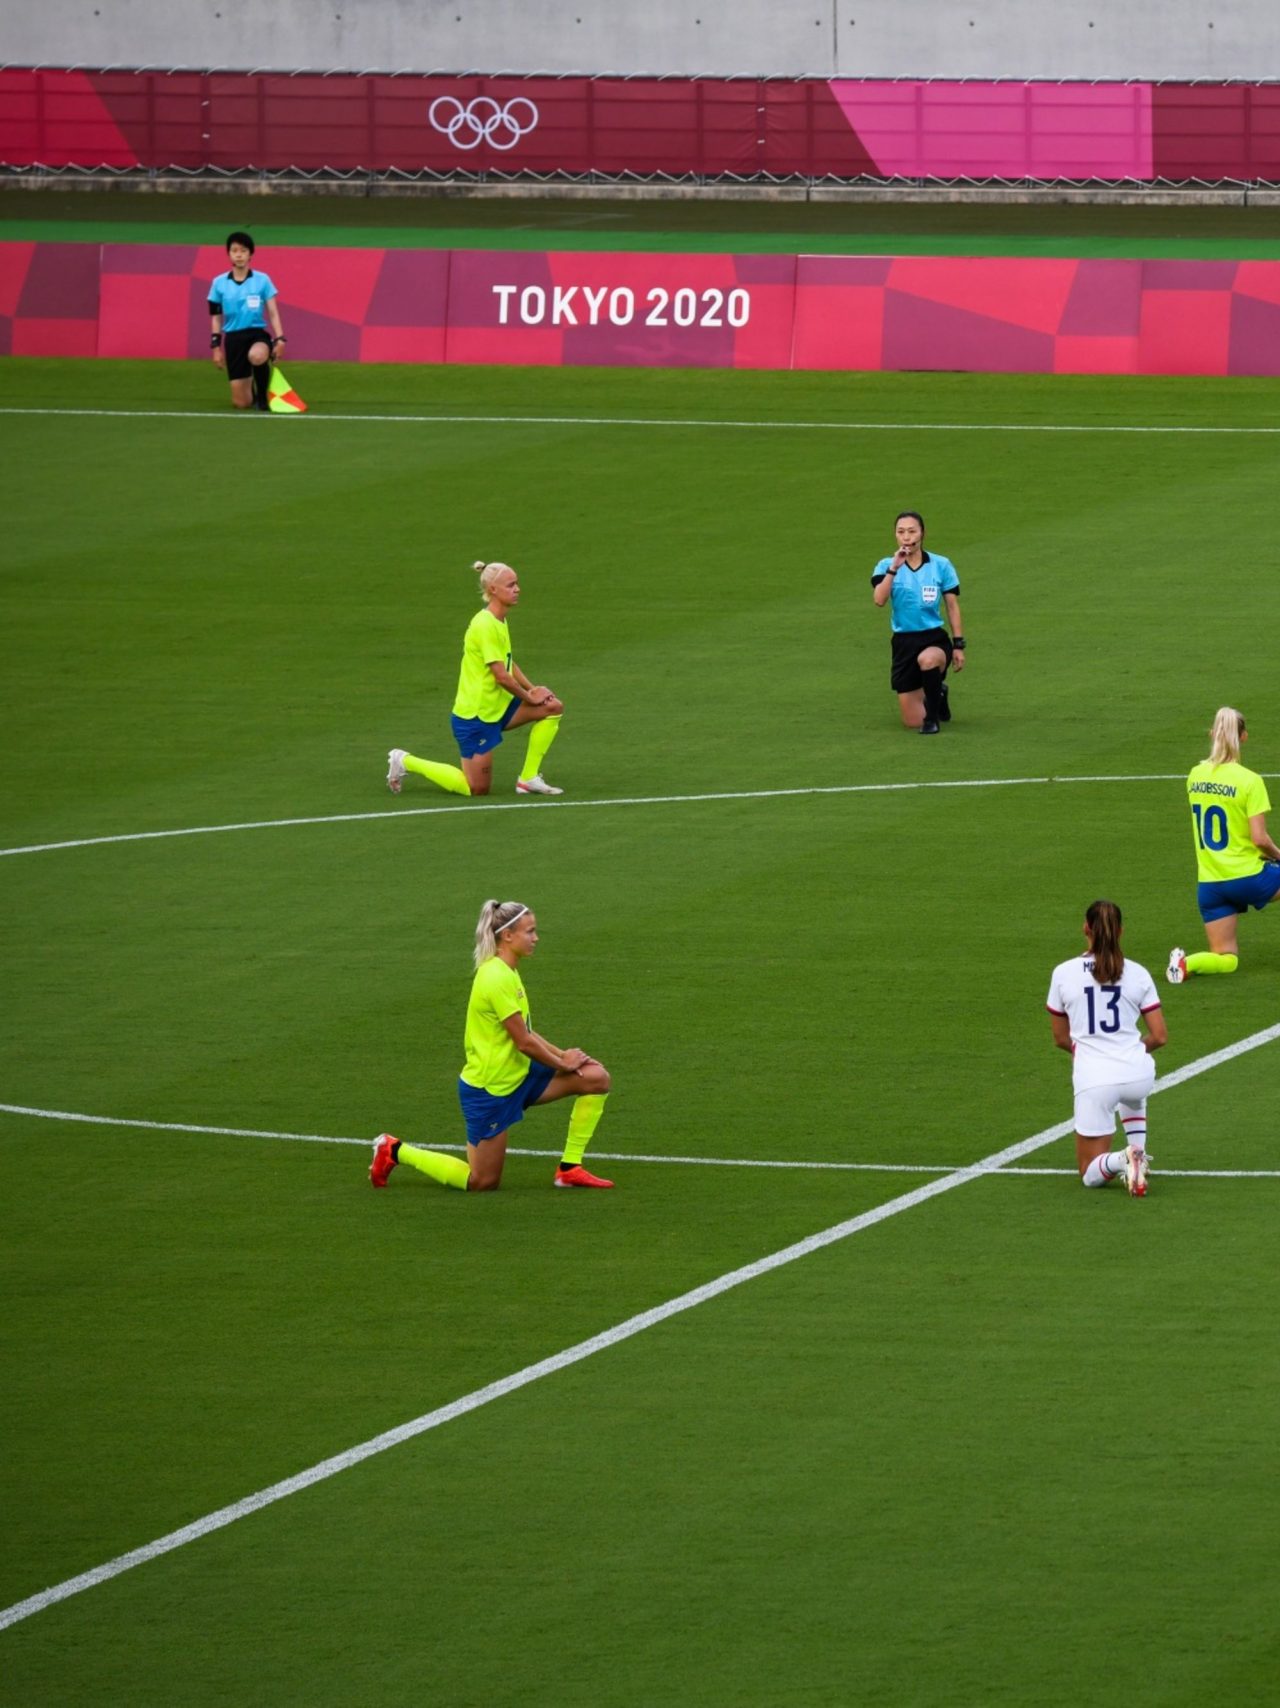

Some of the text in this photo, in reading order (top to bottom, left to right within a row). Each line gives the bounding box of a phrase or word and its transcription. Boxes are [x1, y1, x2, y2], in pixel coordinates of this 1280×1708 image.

[492, 285, 751, 327] TOKYO 2020
[1192, 803, 1229, 852] 10
[1084, 985, 1122, 1035] 13
